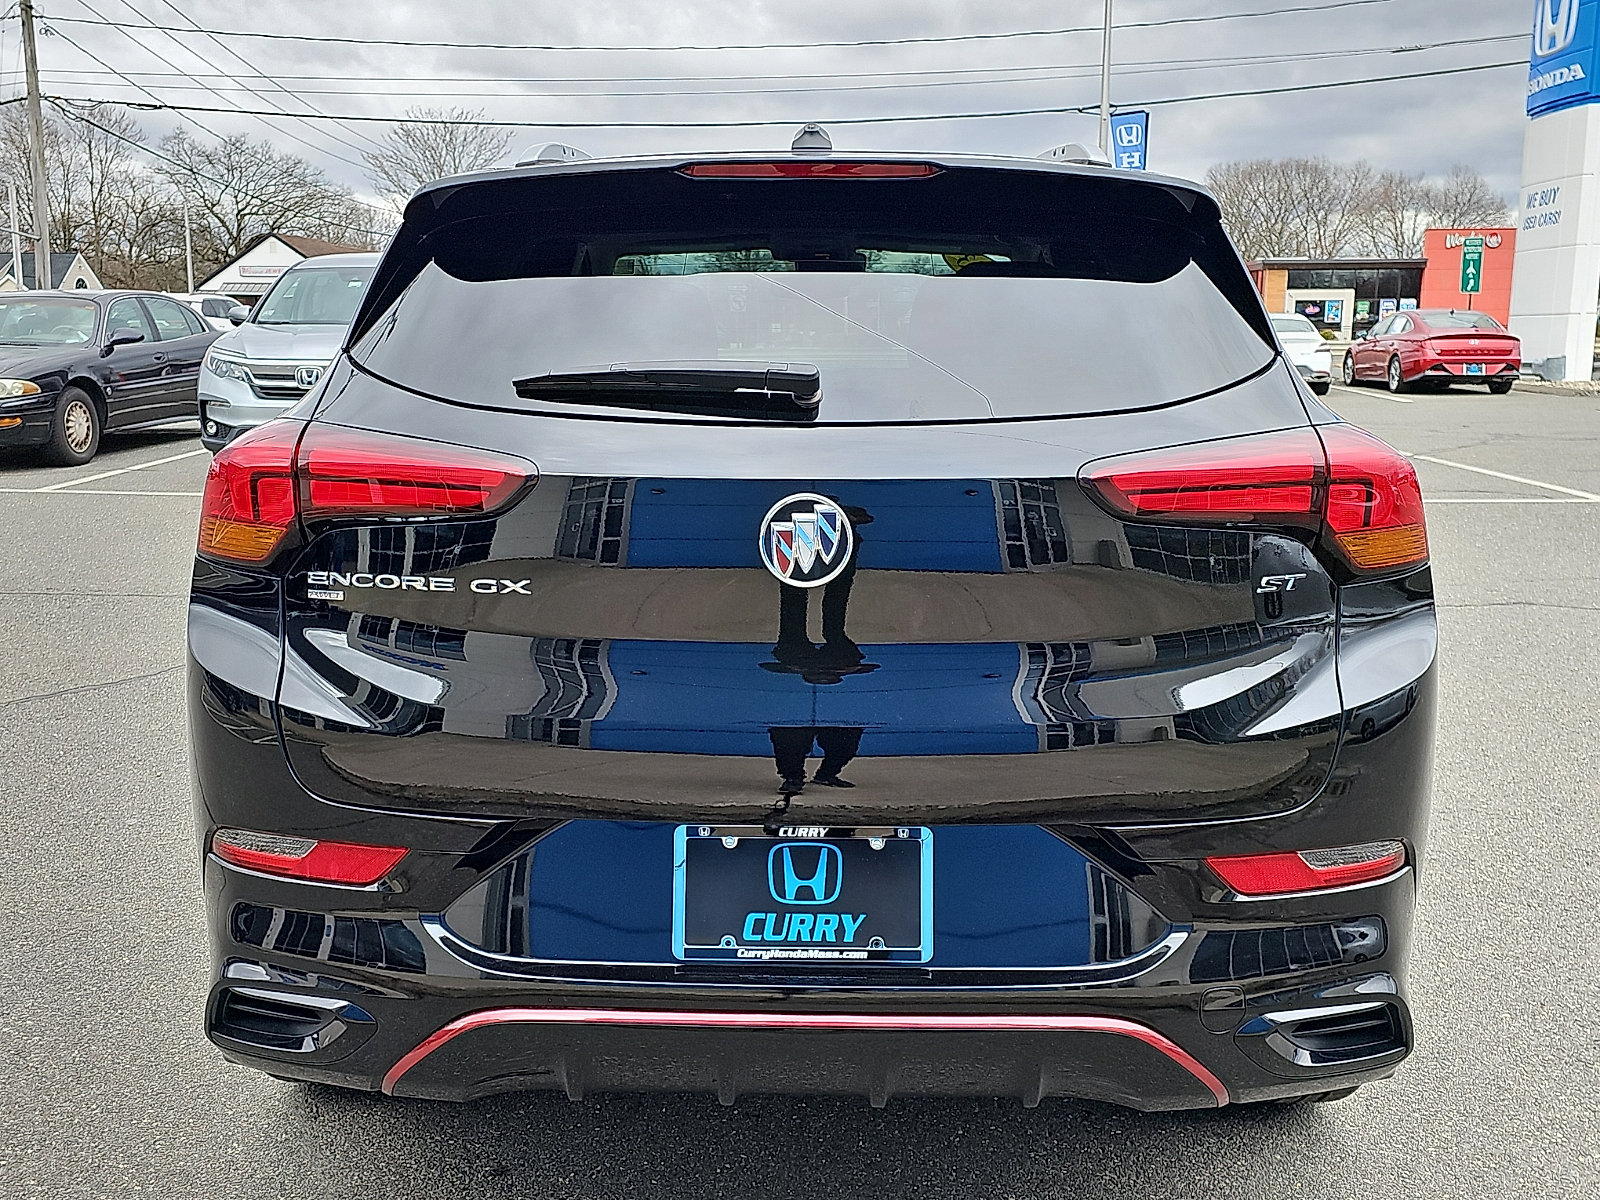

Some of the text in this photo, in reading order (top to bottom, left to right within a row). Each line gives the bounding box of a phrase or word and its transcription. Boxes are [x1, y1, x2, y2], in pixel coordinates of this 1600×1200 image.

[1526, 186, 1560, 209] WE BUY
[1522, 215, 1537, 231] USED
[307, 571, 532, 595] ENCORE GX
[1256, 573, 1307, 594] ST
[778, 827, 829, 838] CURRY
[742, 912, 866, 943] CURRY
[737, 948, 868, 960] CurryHondaMass.com
